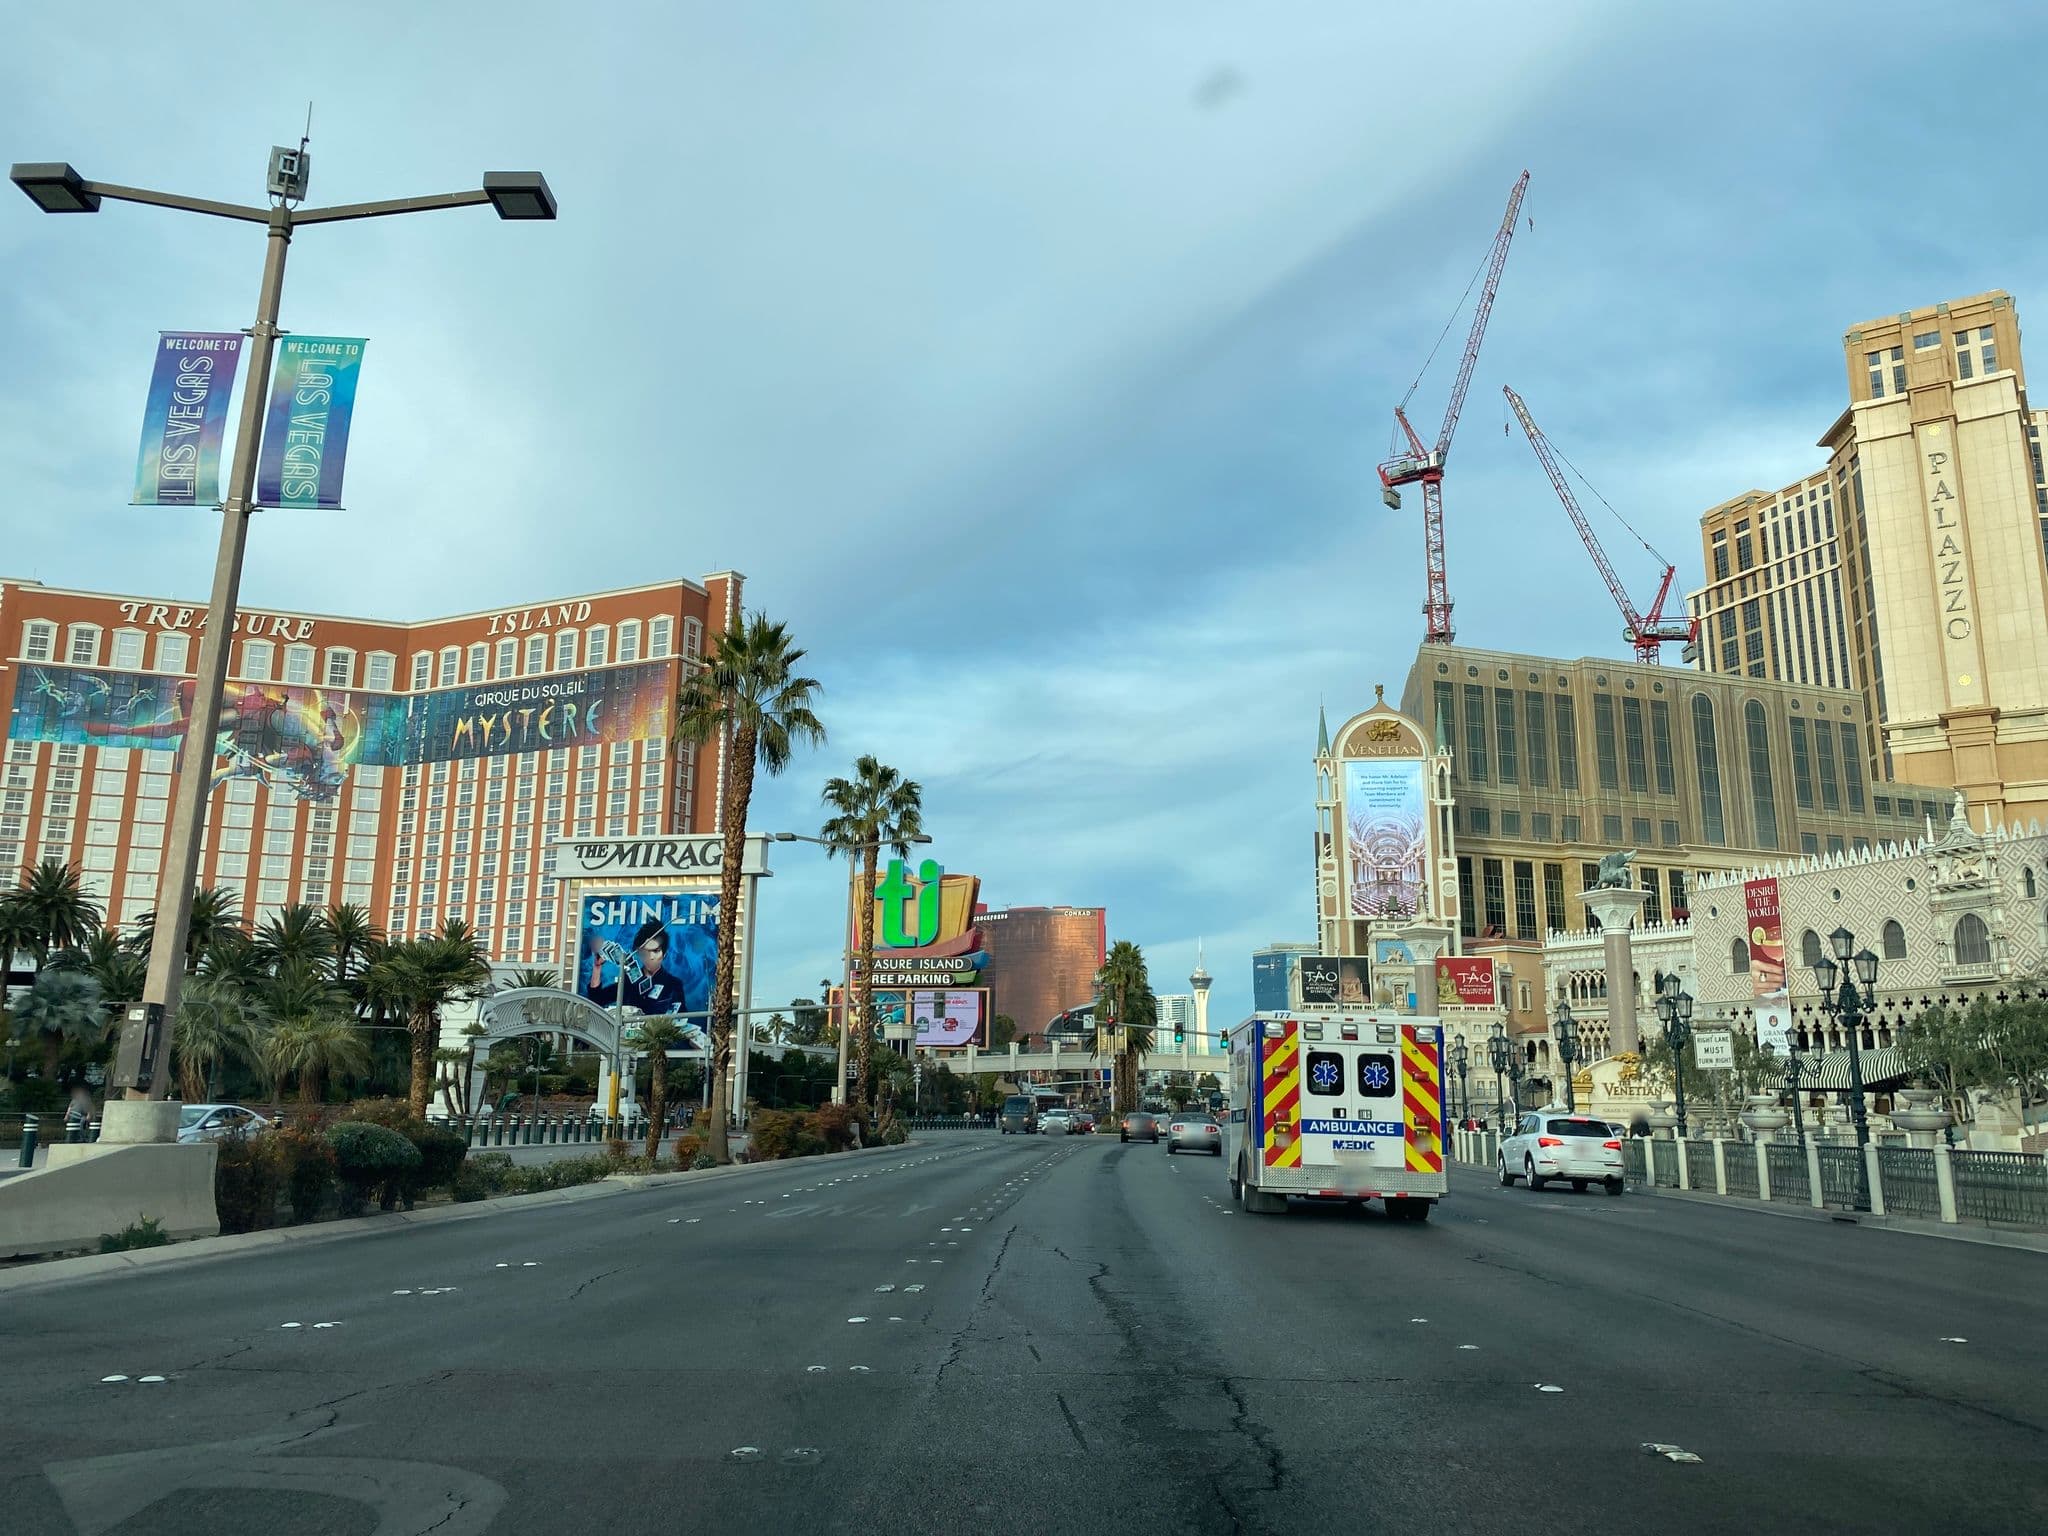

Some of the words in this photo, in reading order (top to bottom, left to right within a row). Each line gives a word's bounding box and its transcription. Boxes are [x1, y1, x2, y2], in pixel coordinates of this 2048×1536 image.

[165, 338, 220, 351] WELCOME
[223, 340, 237, 351] TO
[287, 342, 340, 355] WELCOME
[344, 344, 359, 355] TO
[295, 359, 337, 406] LAS
[165, 356, 214, 438] VEGAS
[282, 412, 328, 499] VEGAS
[159, 443, 197, 498] LAS
[1928, 451, 1971, 641] PALAZZO
[487, 601, 592, 636] ISLAND
[474, 689, 520, 707] CIRQUE
[521, 687, 540, 700] DU
[542, 680, 586, 698] SOLEIL
[1348, 743, 1420, 756] VENETIAN
[574, 843, 609, 860] THE
[580, 840, 723, 871] MIRAG
[1746, 884, 1777, 899] DESIRE
[1753, 896, 1772, 908] THE
[590, 900, 662, 926] SHIN
[670, 900, 722, 926] LIM
[1063, 910, 1092, 918] CONRAD
[1747, 905, 1780, 919] WORLD
[854, 958, 913, 970] TASURE
[920, 958, 964, 970] ISLAND
[871, 974, 895, 984] REE
[897, 974, 950, 985] PARKING
[1304, 970, 1338, 983] TAO
[1456, 972, 1493, 985] TAO
[1273, 1011, 1292, 1019] 177
[1714, 1035, 1730, 1043] LANE
[1703, 1046, 1725, 1054] MUST
[1715, 1056, 1732, 1064] RIGHT
[1602, 1082, 1662, 1097] VENETIAN
[1309, 1121, 1395, 1135] AMBULANCE
[1332, 1139, 1376, 1151] MEDIC
